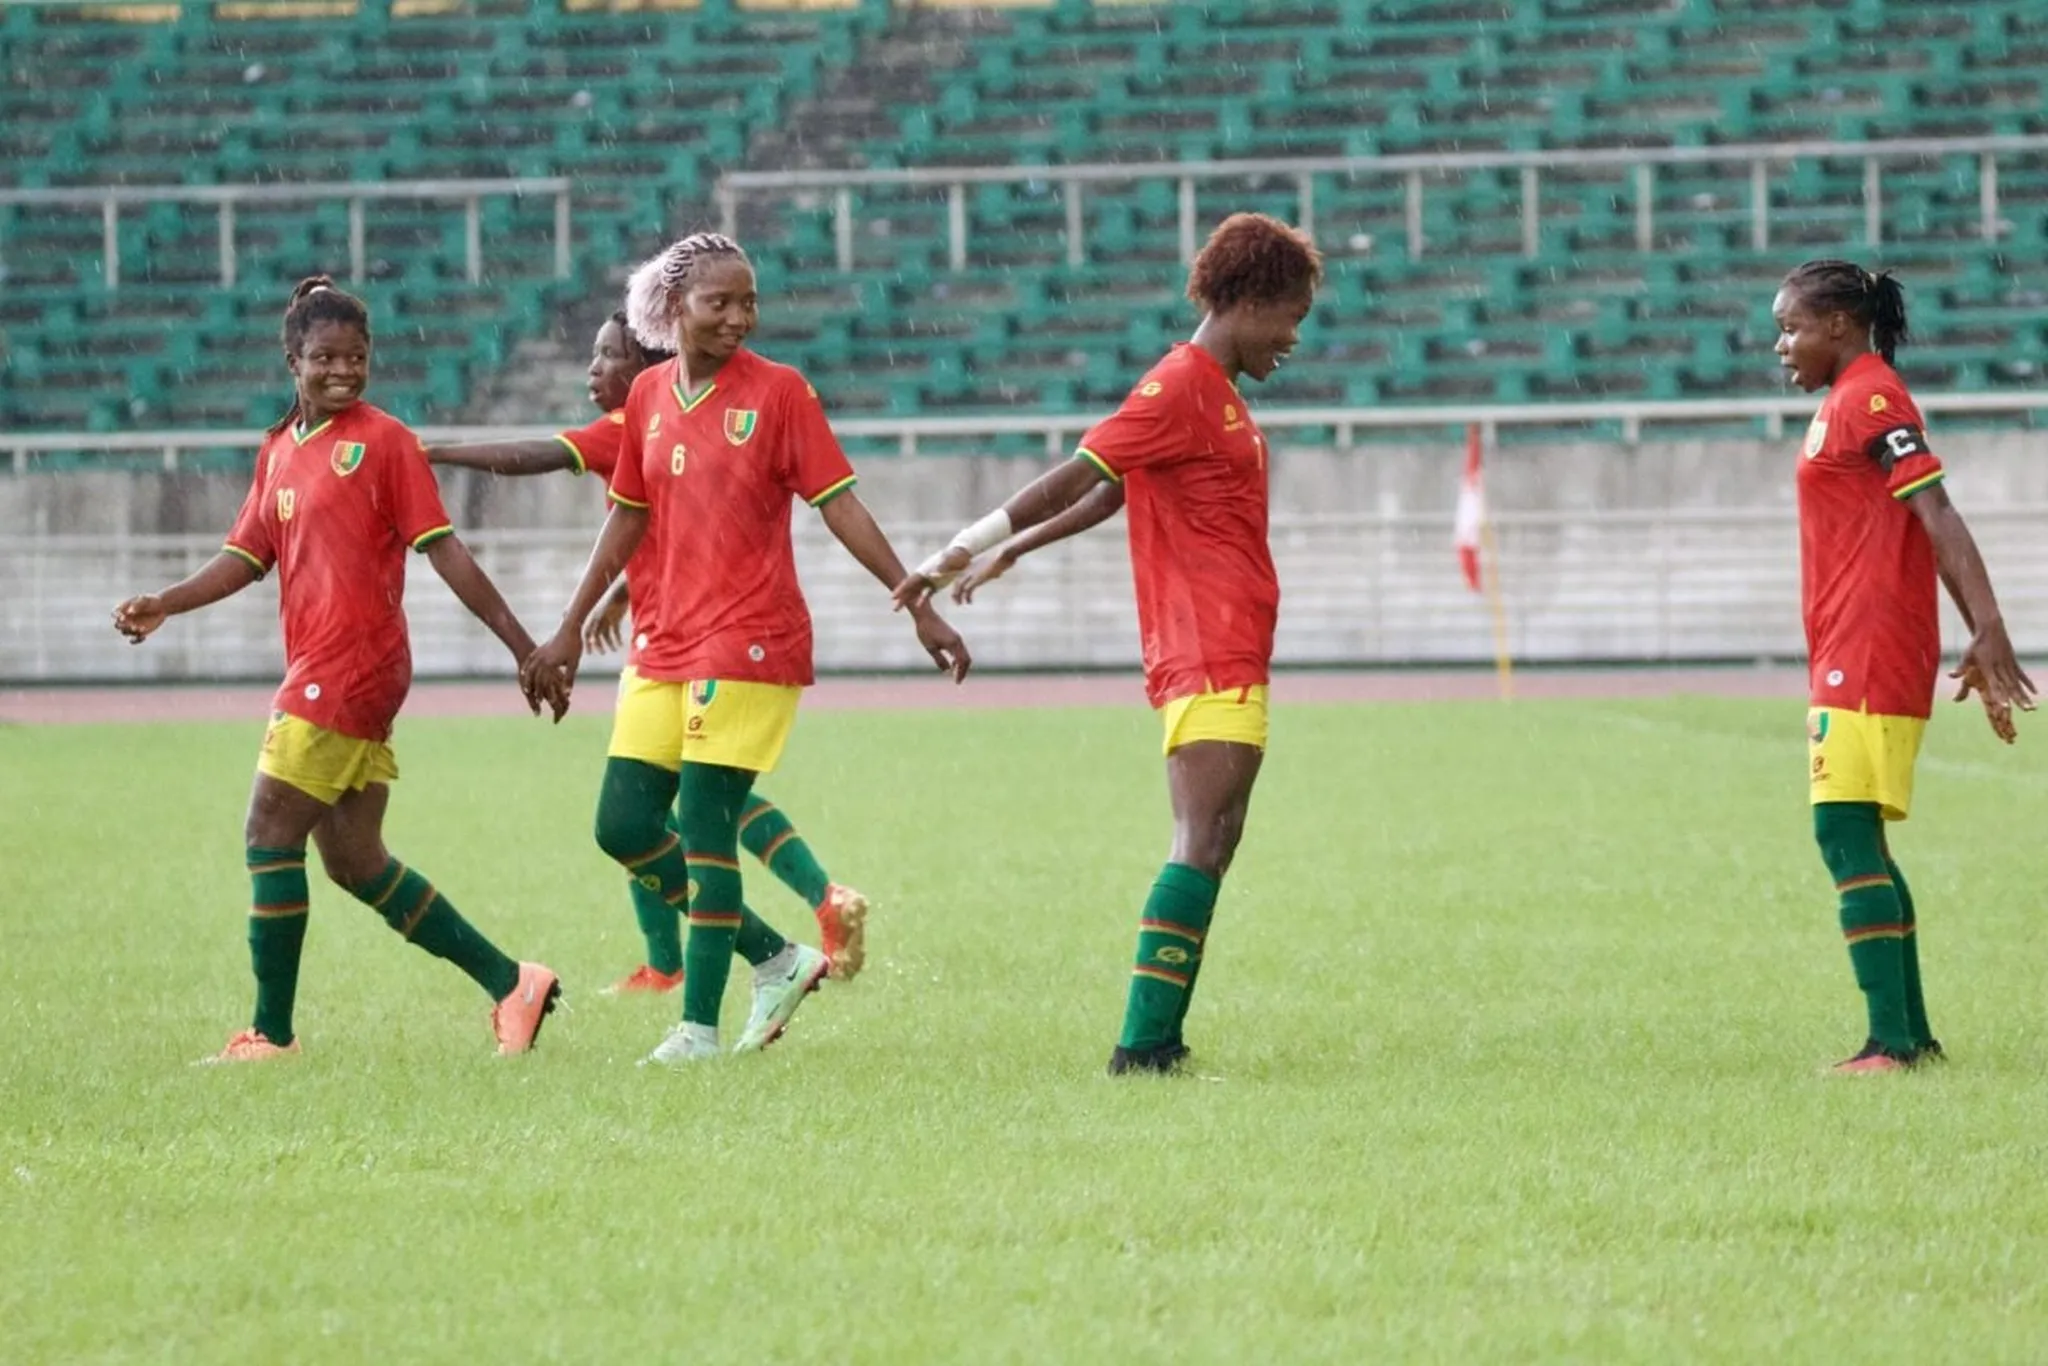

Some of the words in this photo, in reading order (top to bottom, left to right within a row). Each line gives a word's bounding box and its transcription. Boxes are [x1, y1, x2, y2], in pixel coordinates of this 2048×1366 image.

[671, 442, 686, 476] 6
[1886, 428, 1916, 457] C
[275, 487, 296, 522] 19
